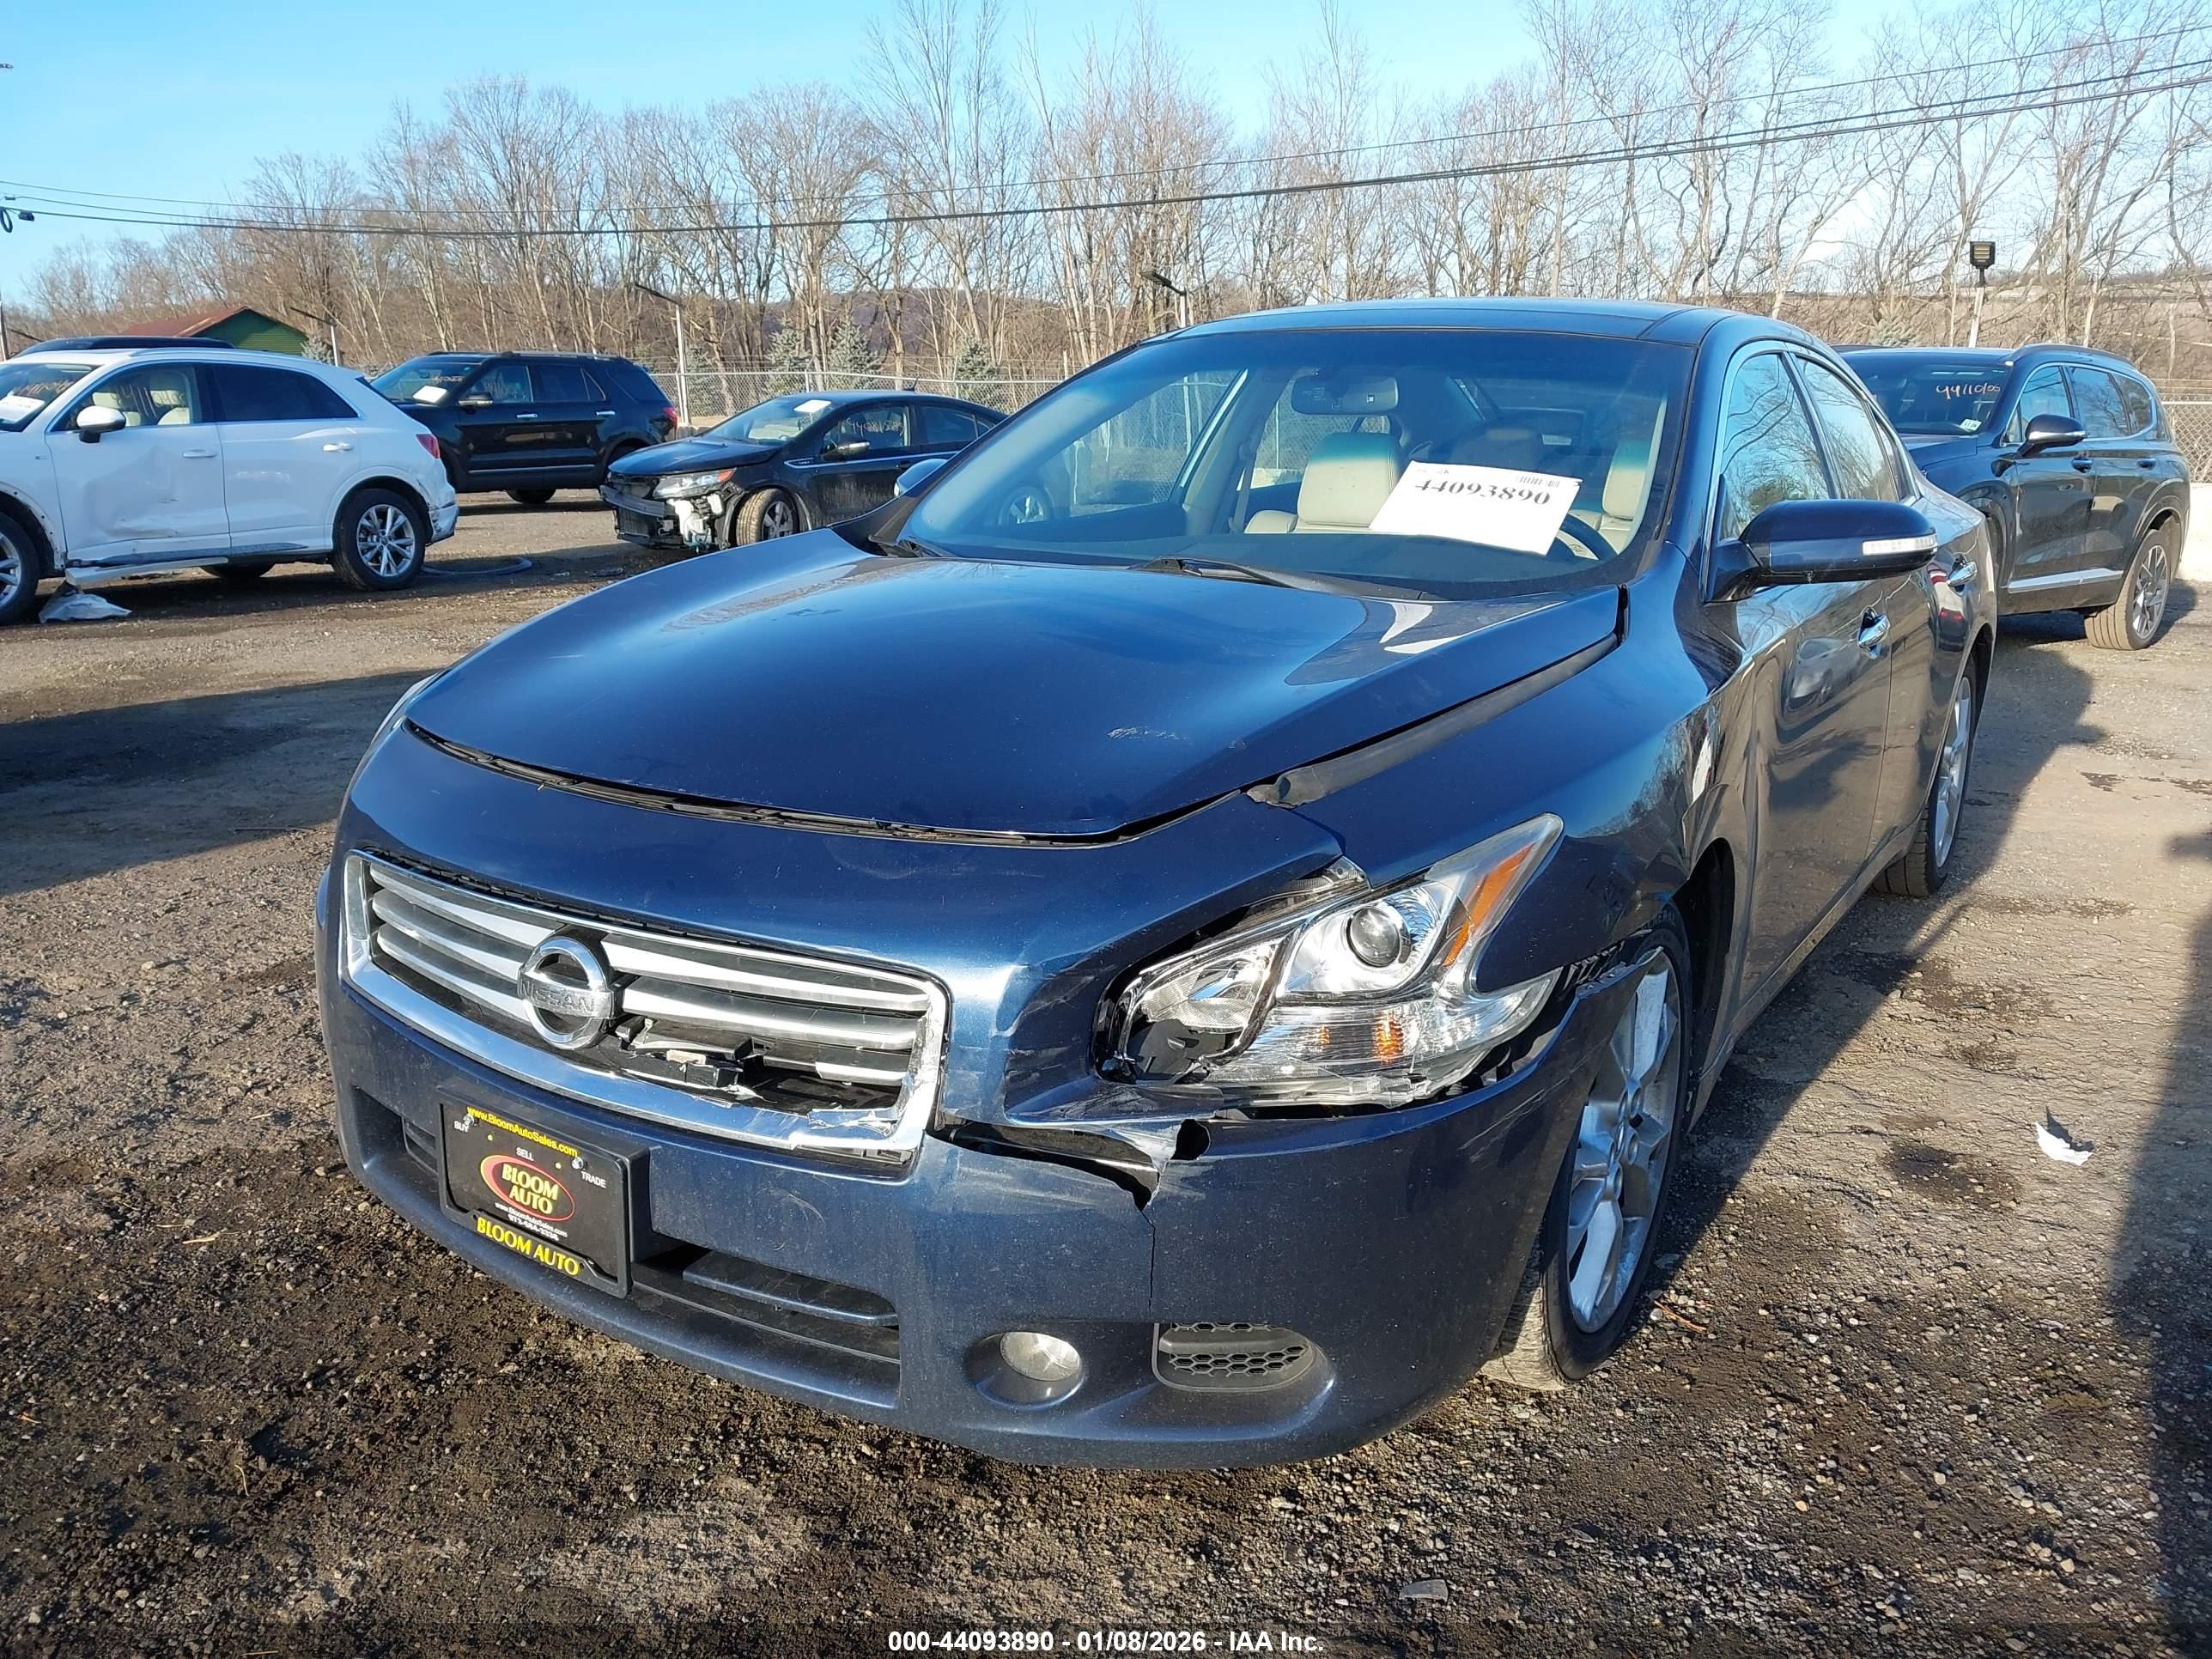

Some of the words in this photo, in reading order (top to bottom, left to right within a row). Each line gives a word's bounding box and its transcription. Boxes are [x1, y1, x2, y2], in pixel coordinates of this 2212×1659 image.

[1414, 478, 1551, 505] 44093890
[518, 980, 595, 1013] NISSAN
[453, 1120, 470, 1133] BUY
[467, 1106, 579, 1158] www.BloomAutoSales.com
[516, 1146, 535, 1162] SELL
[501, 1163, 559, 1201] BLOOM
[580, 1170, 606, 1188] TRADE
[508, 1184, 554, 1215] AUTO
[476, 1217, 532, 1256] BLOOM
[535, 1246, 580, 1276] AUTO
